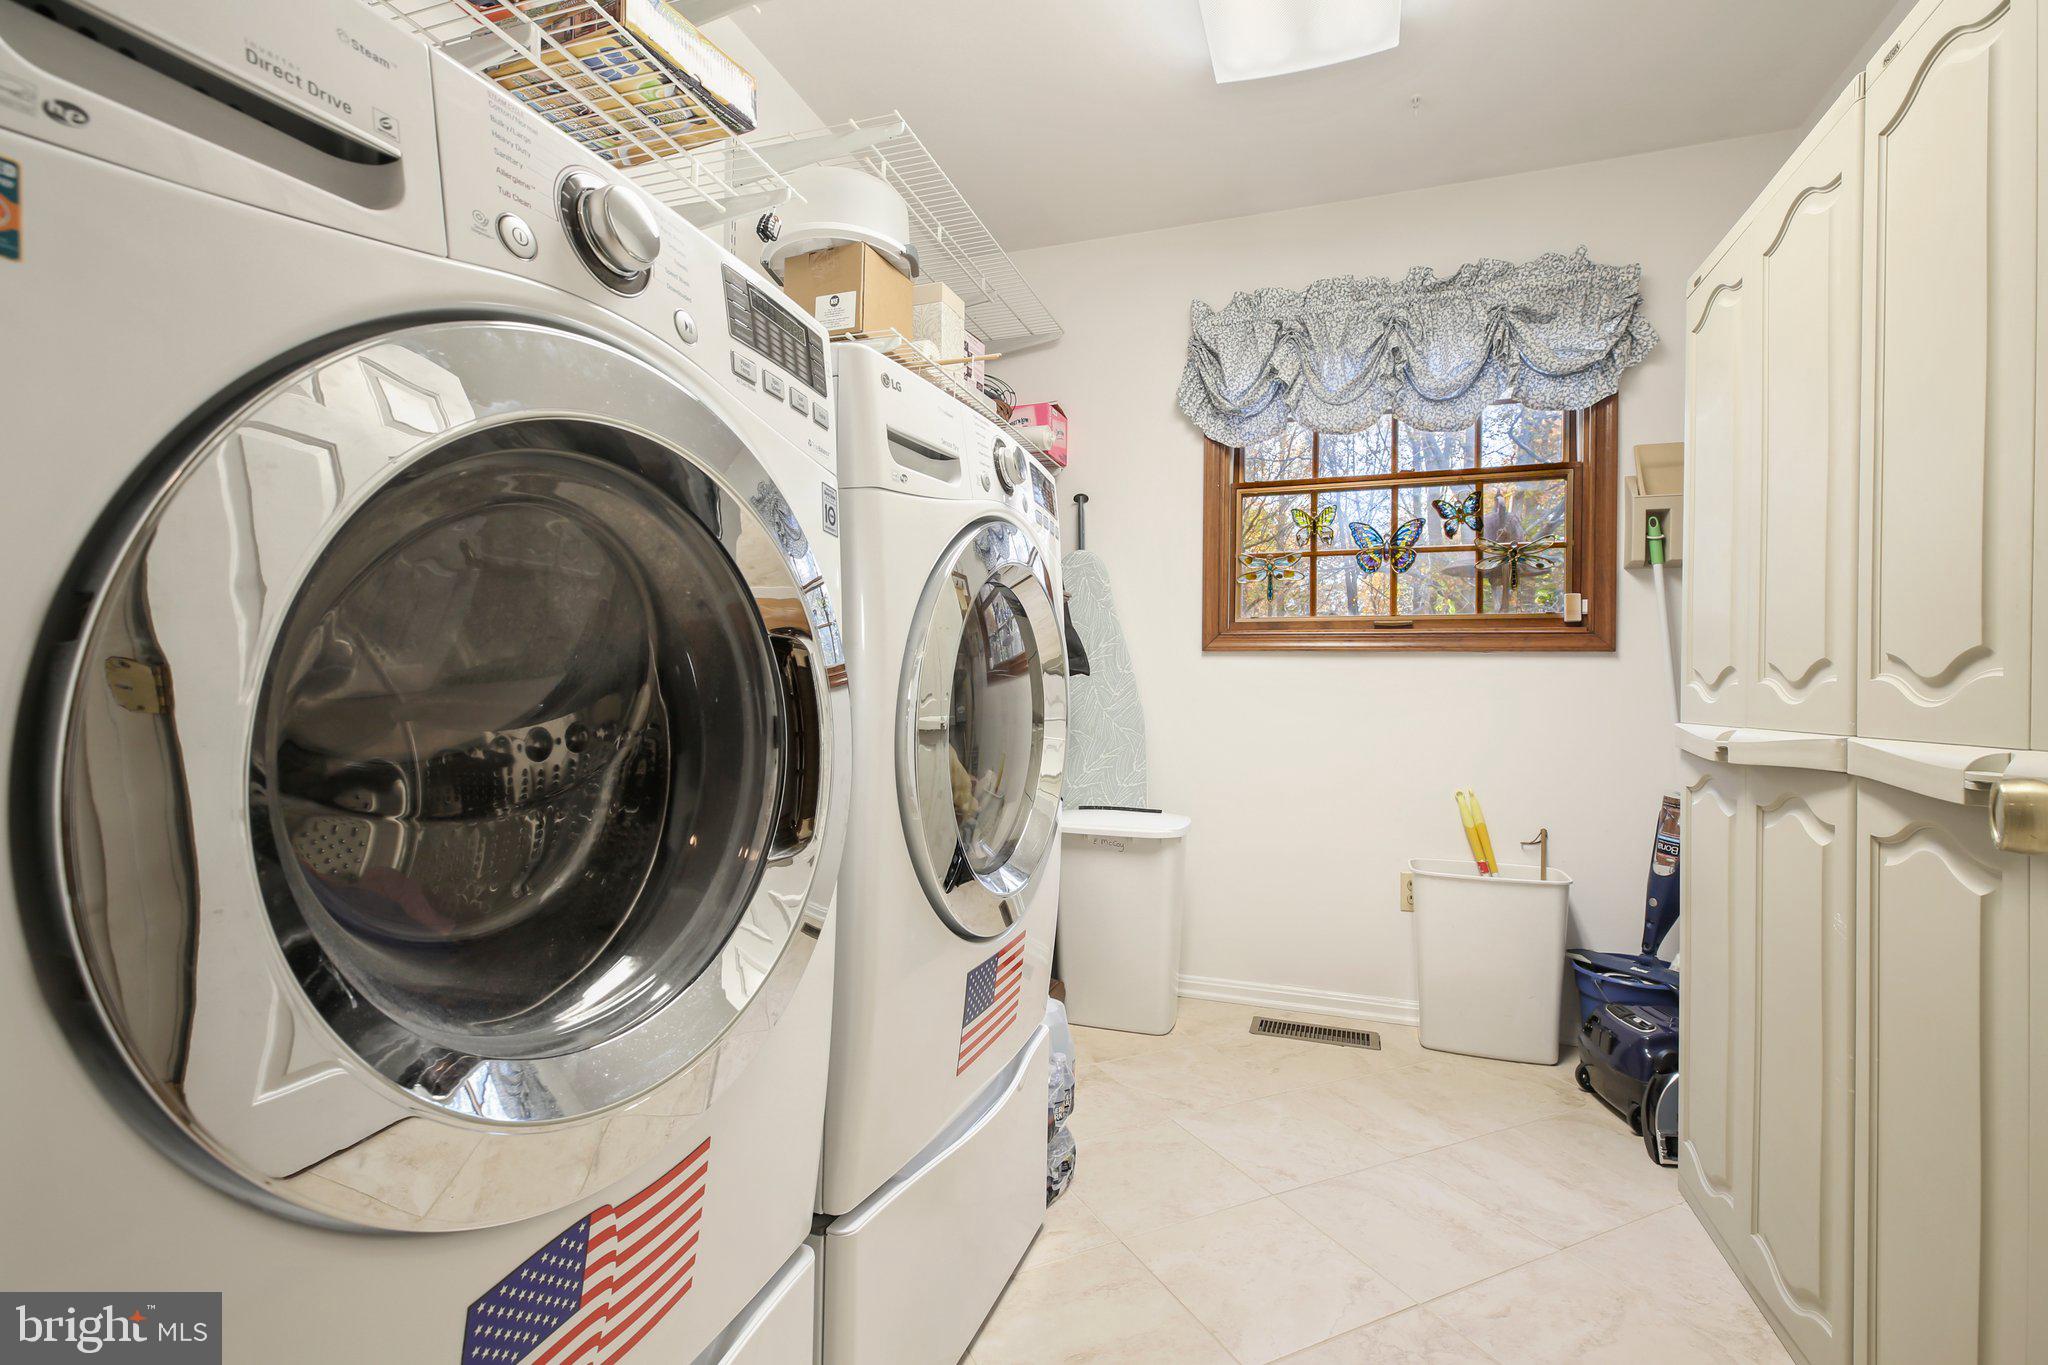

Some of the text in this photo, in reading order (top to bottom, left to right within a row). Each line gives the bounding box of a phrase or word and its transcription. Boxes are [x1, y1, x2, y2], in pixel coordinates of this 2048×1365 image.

[350, 38, 391, 70] Steam
[245, 47, 353, 115] Direct Drive
[891, 379, 902, 392] LG
[1657, 842, 1679, 855] Bona
